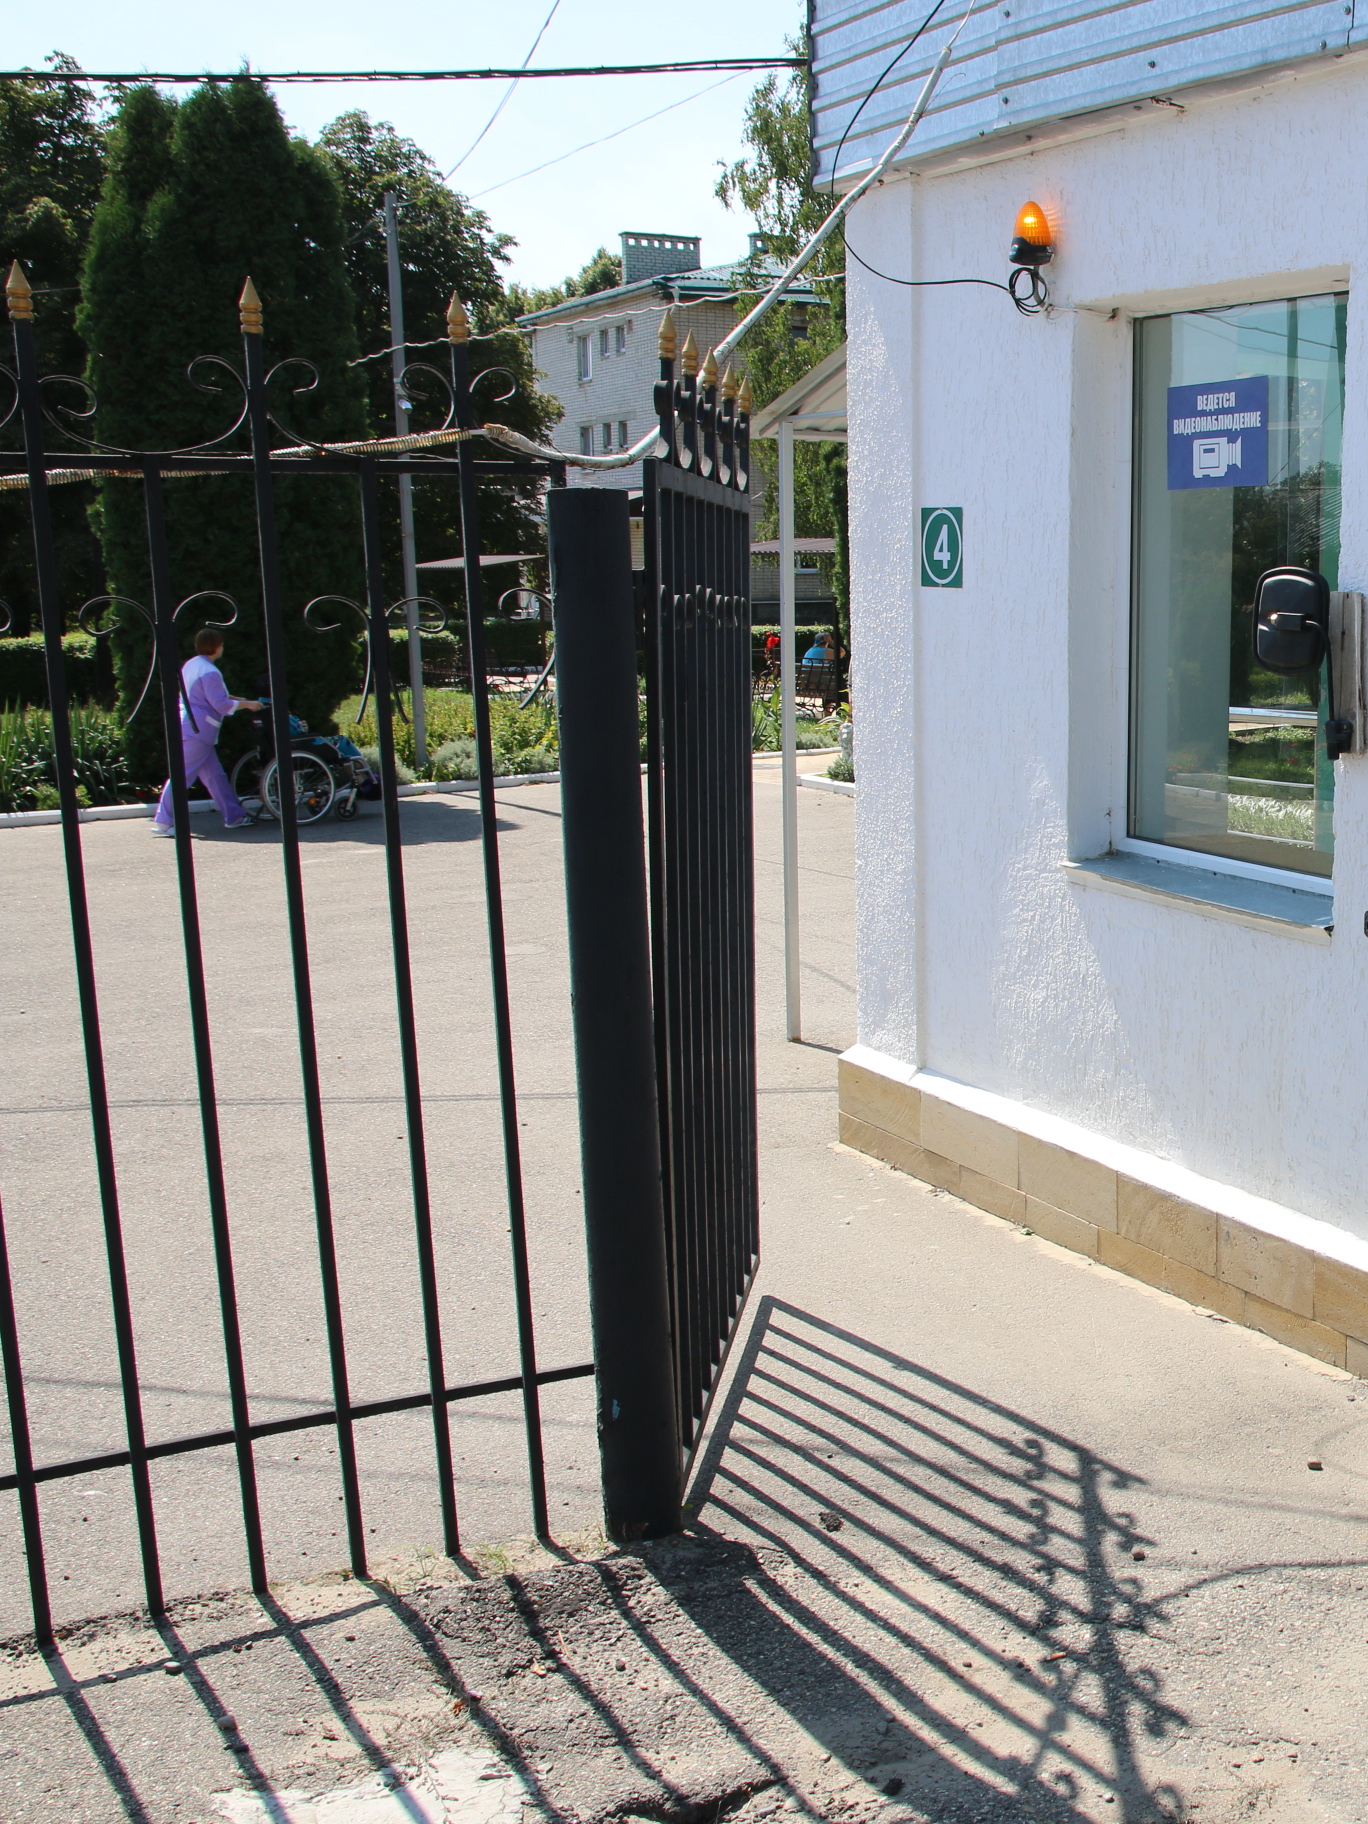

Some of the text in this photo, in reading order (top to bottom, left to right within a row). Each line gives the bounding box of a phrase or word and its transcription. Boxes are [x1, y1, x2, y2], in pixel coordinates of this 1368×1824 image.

[1197, 391, 1236, 412] ВЕДЕТСЯ
[1173, 411, 1262, 436] ВИДЕОНАБЛЮДЕНИЕ
[933, 524, 951, 569] 4
